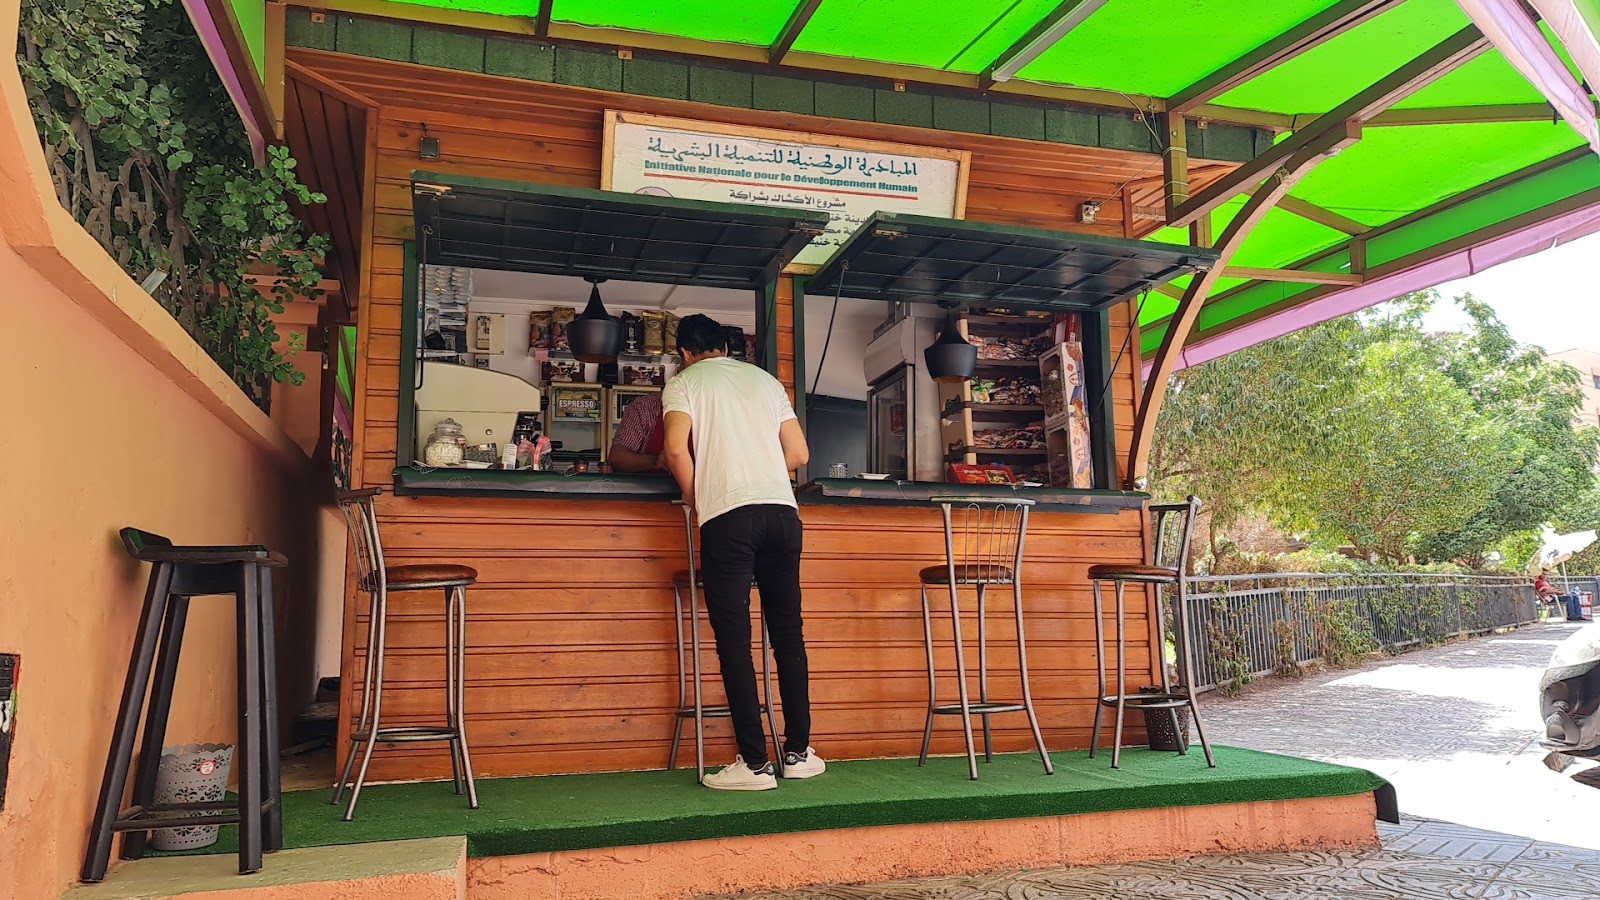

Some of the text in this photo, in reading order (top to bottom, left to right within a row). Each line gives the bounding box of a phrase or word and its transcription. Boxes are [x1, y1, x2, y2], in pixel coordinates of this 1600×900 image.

[647, 136, 918, 177] المبادرة الوطنية للتنمية البشرية
[644, 160, 918, 193] Initiative Nationale pour le Développement Humain
[729, 188, 769, 203] بشراكة
[816, 197, 847, 209] مشروع
[559, 400, 594, 408] ESPRESSO
